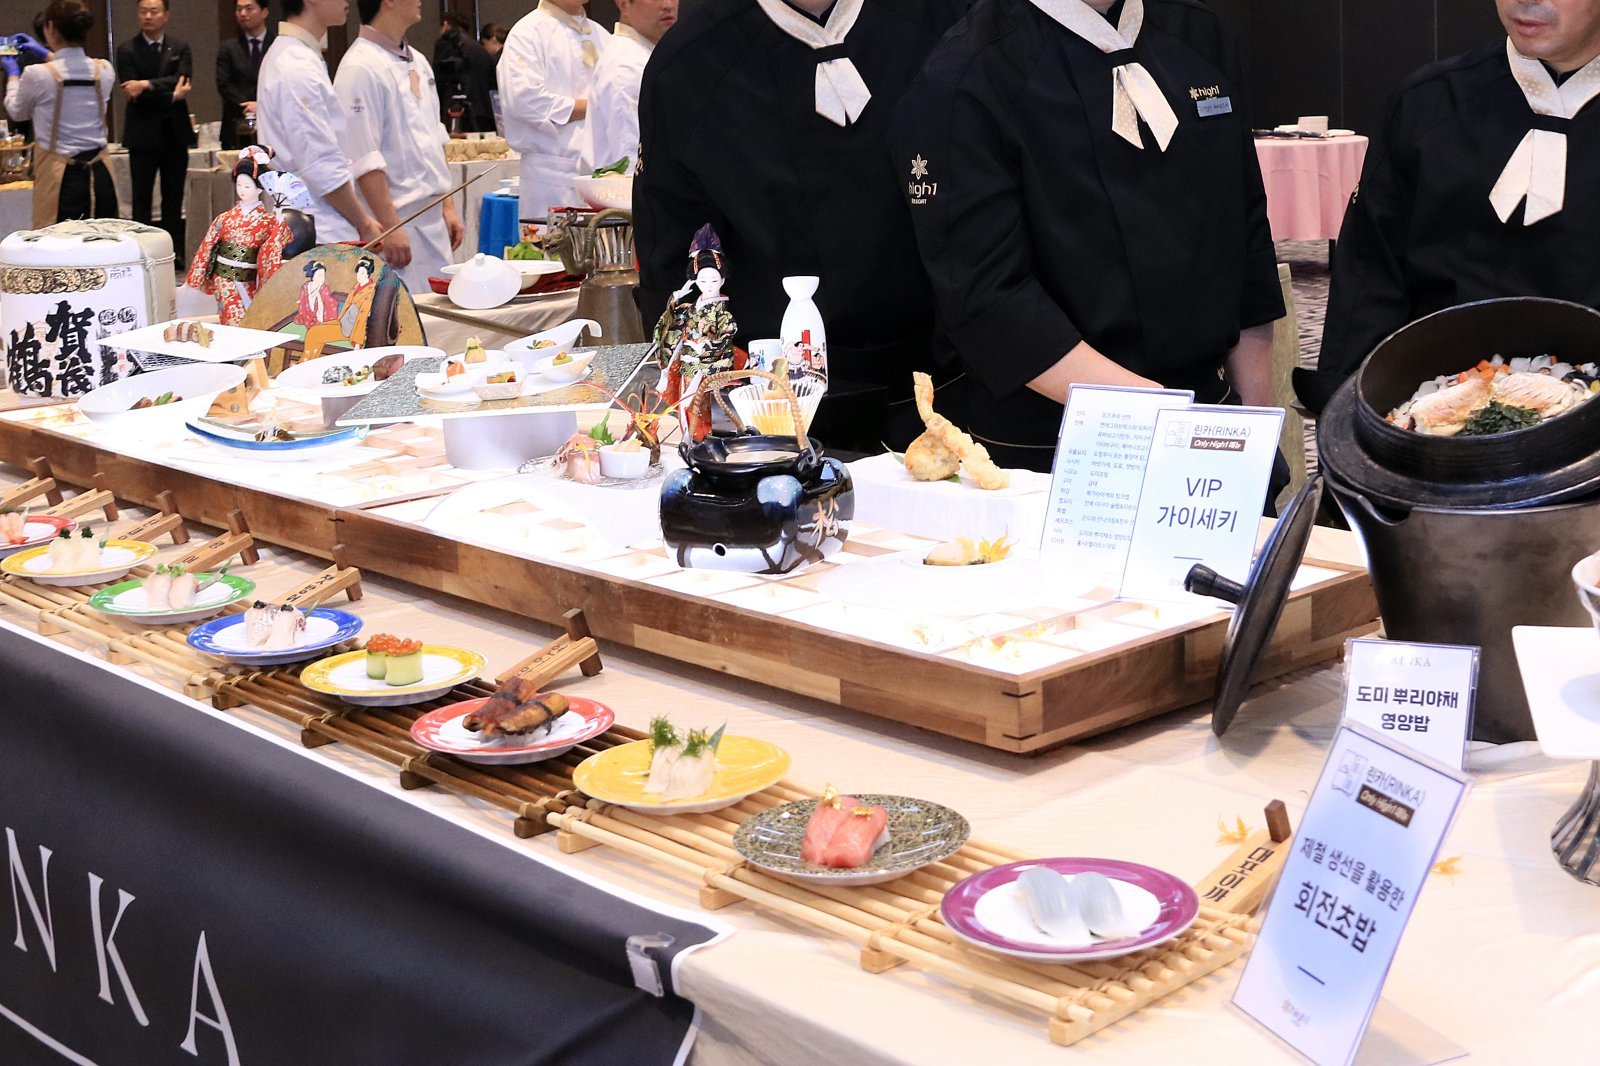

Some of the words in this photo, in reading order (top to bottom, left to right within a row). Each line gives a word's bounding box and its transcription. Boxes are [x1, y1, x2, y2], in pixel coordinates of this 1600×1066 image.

[1198, 85, 1220, 97] high1
[908, 181, 937, 198] high1
[1194, 424, 1251, 438] 린카(RINKA)
[1194, 439, 1210, 448] Only
[1210, 440, 1228, 449] High1
[1186, 476, 1223, 498] VIP
[1156, 504, 1239, 533] 가이세키
[1356, 685, 1389, 705] 도미
[1392, 687, 1459, 710] 뿌리야채
[1380, 712, 1431, 734] 영양밥
[1366, 766, 1426, 808] 린카(RINKA)
[1202, 846, 1276, 903] 대포이까
[1299, 836, 1327, 866] 제철
[1327, 847, 1366, 886] 생선을
[1364, 863, 1406, 912] 활용한
[1294, 879, 1378, 955] 회전초밥
